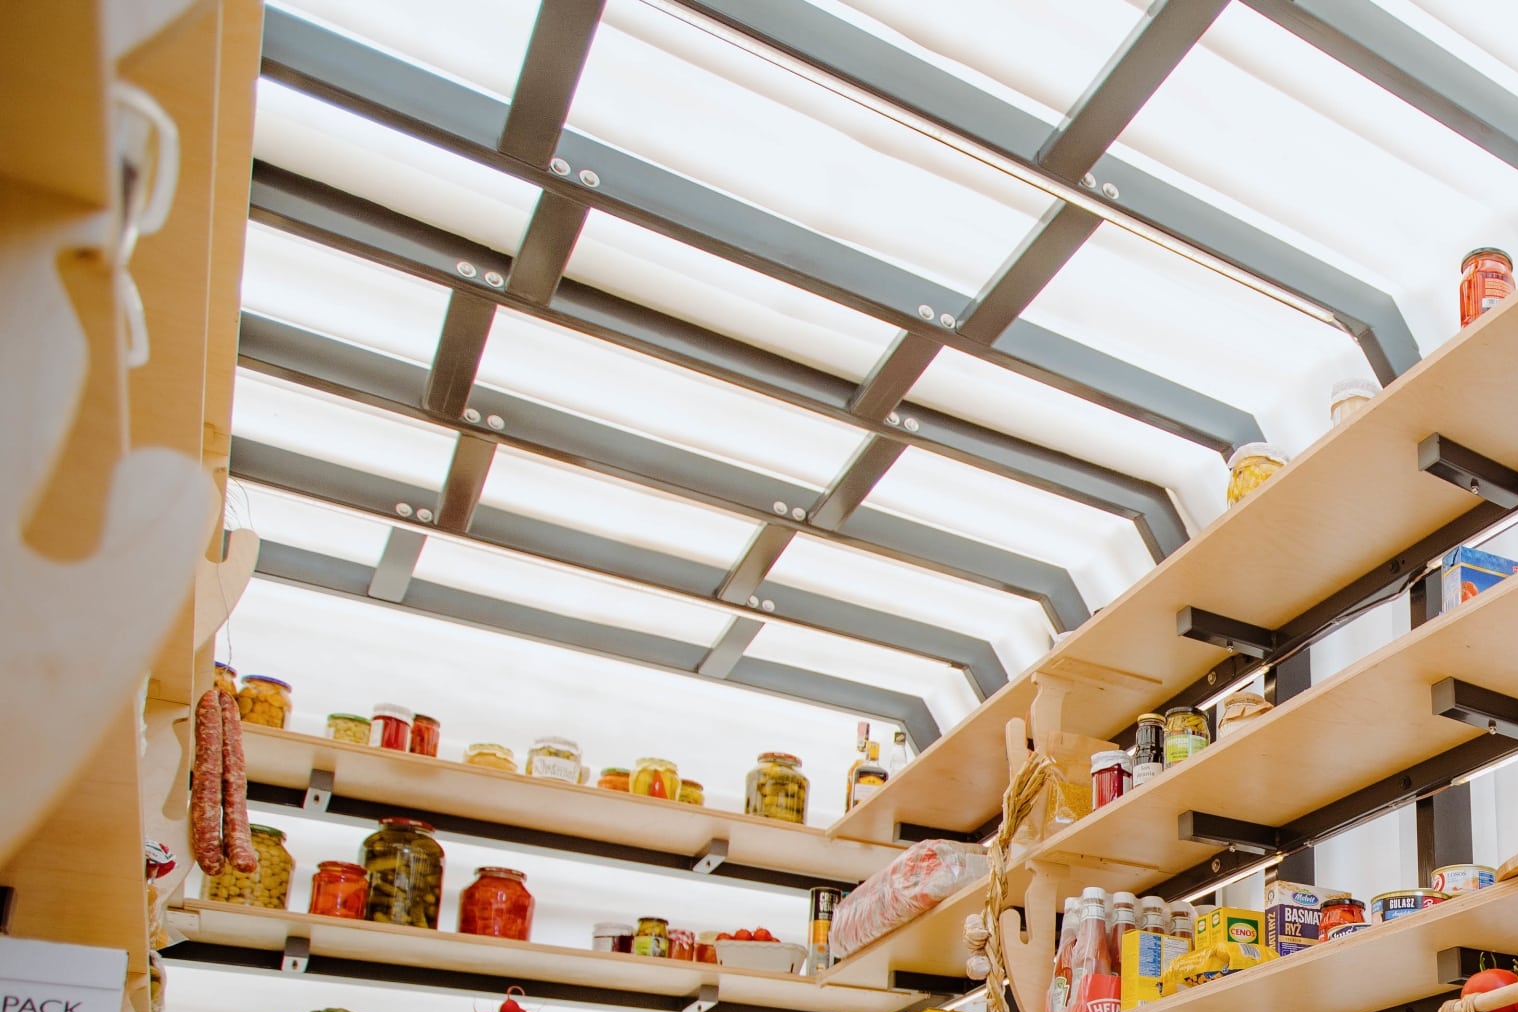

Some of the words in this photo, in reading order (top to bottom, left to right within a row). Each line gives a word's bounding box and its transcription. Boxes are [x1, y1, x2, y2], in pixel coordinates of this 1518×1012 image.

[1389, 897, 1415, 910] GULASZ
[1230, 927, 1256, 938] CENOS
[1284, 922, 1302, 937] RYŻ
